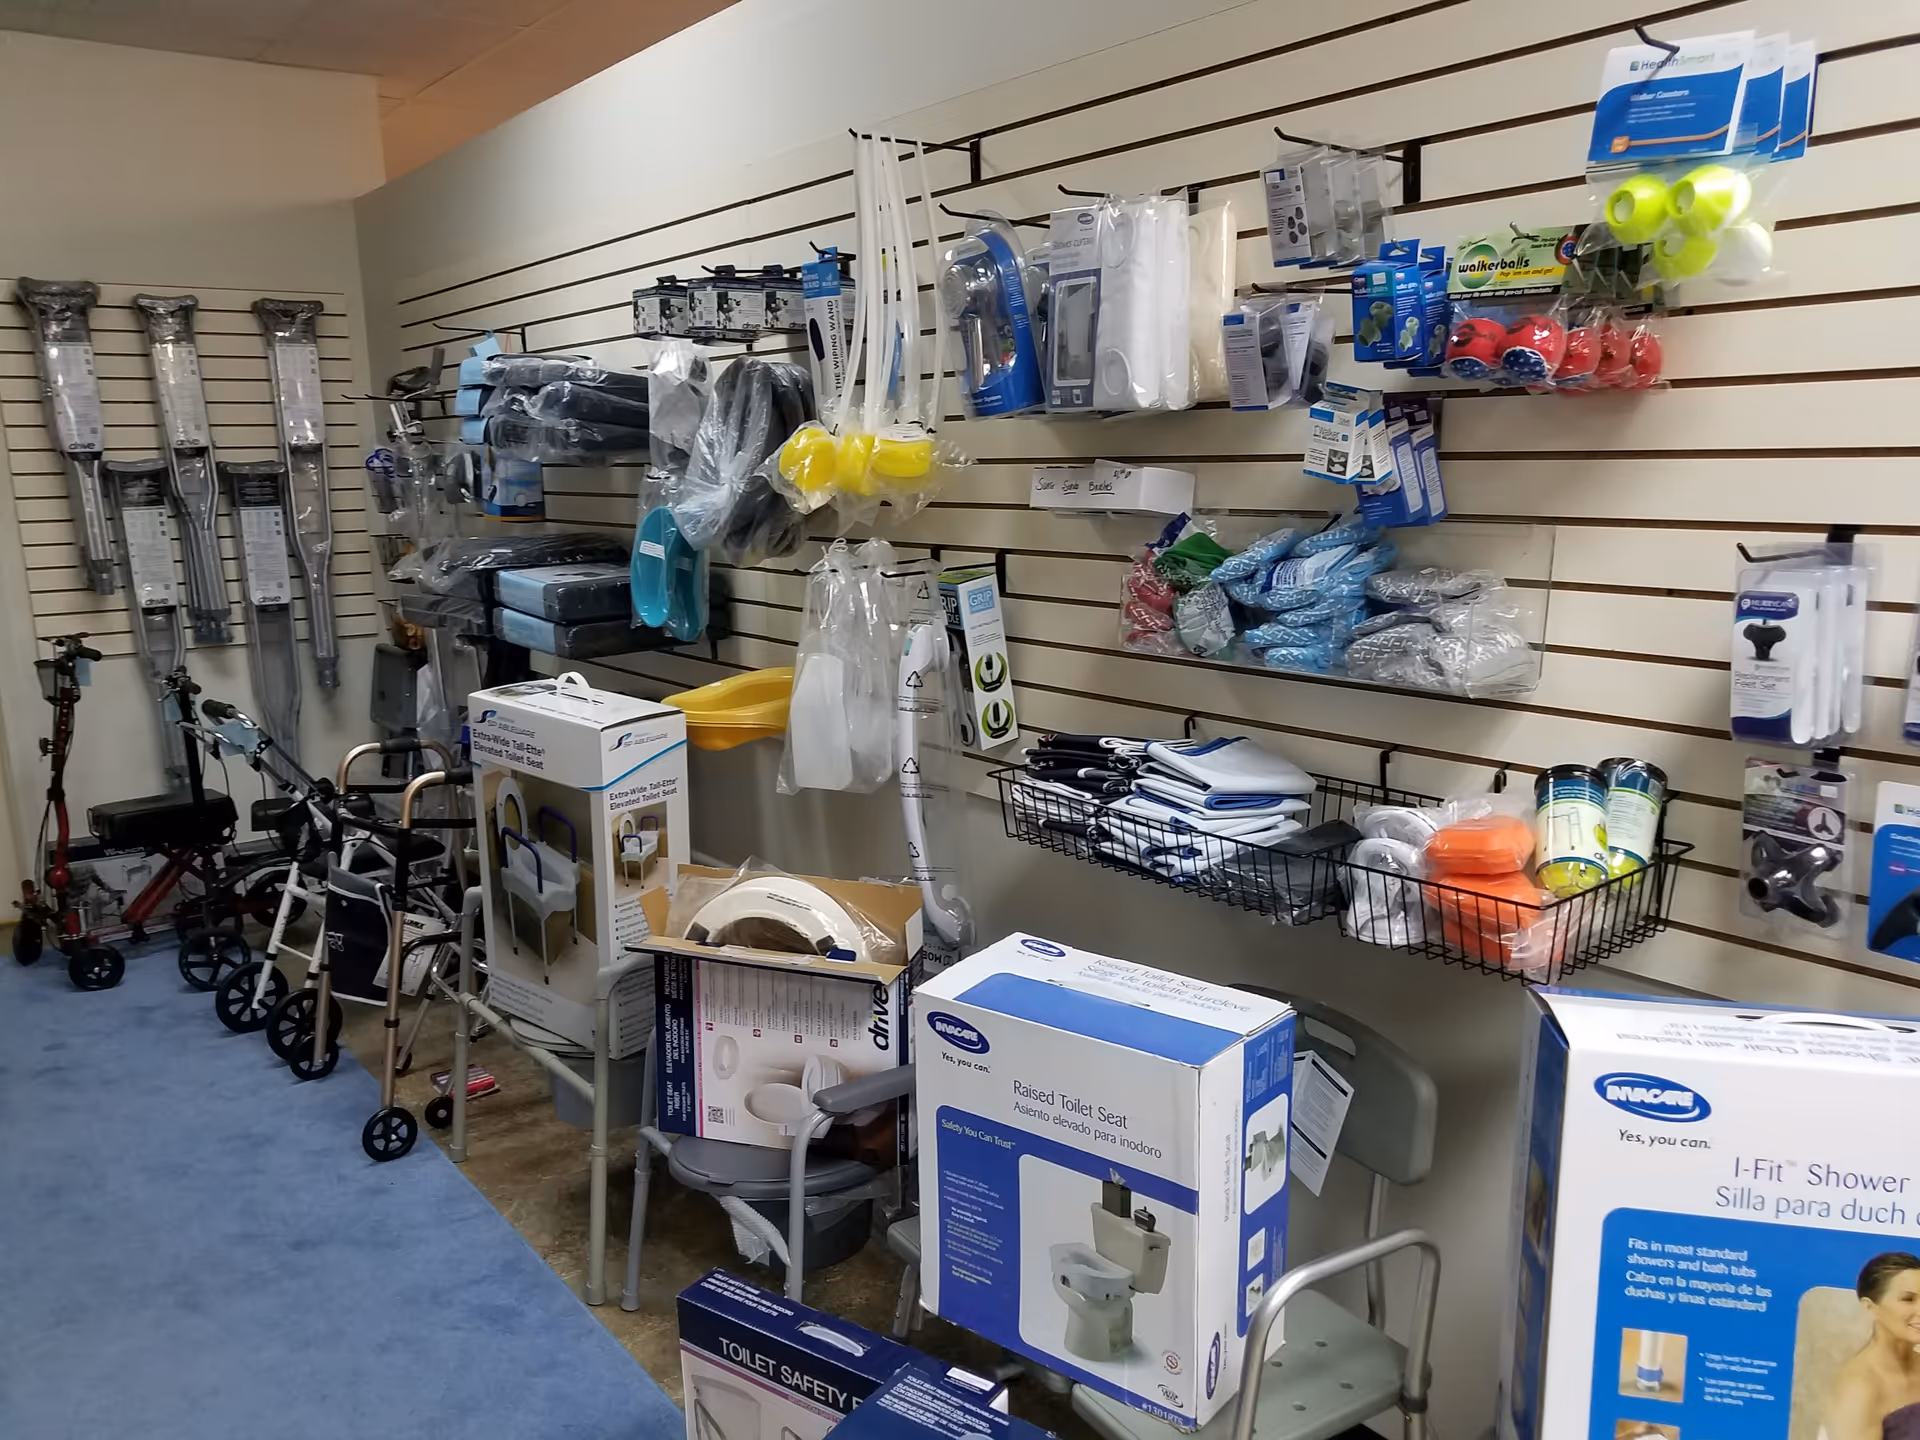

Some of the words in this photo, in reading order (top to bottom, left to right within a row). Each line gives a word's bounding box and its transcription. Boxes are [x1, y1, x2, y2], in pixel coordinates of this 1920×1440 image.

[1458, 256, 1530, 274] walkerballs
[827, 300, 836, 332] WAND
[828, 334, 839, 371] WIPING
[68, 440, 96, 450] drive
[144, 596, 169, 606] drive
[258, 594, 282, 604] drive
[970, 590, 992, 606] GRIP
[1734, 671, 1790, 683] Replacement
[1734, 679, 1757, 690] Feet
[1760, 682, 1776, 690] Set
[472, 728, 511, 748] Extra-Wide
[474, 740, 504, 758] Elevated
[504, 750, 526, 764] Toilet
[526, 757, 544, 770] Seat
[609, 786, 648, 802] Extra-Wide
[610, 794, 642, 811] Elevated
[642, 790, 660, 804] Toilet
[661, 786, 678, 798] Seat
[1094, 959, 1140, 976] Raised
[1140, 967, 1176, 986] Toilet
[1178, 978, 1208, 992] Seat
[664, 1004, 672, 1030] ASIENTO
[868, 984, 890, 1051] drive
[935, 1020, 978, 1042] INVACARE
[942, 1052, 956, 1064] Yes,
[957, 1058, 972, 1069] you
[1013, 1080, 1055, 1106] Raised
[1058, 1093, 1094, 1119] Toilet
[1097, 1106, 1128, 1130] Seat
[1606, 1085, 1694, 1109] INVACARE
[941, 1118, 964, 1135] Safety
[963, 1124, 978, 1139] You
[978, 1130, 993, 1144] Can
[1014, 1101, 1050, 1123] Asiento
[1052, 1113, 1091, 1136] elevado
[1094, 1128, 1117, 1144] para
[1120, 1136, 1162, 1159] inodoro
[1618, 1128, 1645, 1145] Yes,
[1648, 1135, 1677, 1149] you
[1680, 1136, 1712, 1150] can.
[1807, 1162, 1912, 1194] Shower
[1716, 1184, 1766, 1212] Silla
[1775, 1194, 1832, 1220] para
[1841, 1198, 1906, 1225] duch
[1628, 1237, 1648, 1250] Fits
[1651, 1240, 1662, 1252] in
[1664, 1245, 1694, 1256] most
[1696, 1247, 1748, 1262] standard
[1626, 1253, 1675, 1269] showers
[1677, 1260, 1700, 1272] and
[1702, 1262, 1729, 1275] bath
[1730, 1266, 1757, 1278] tubs
[1624, 1284, 1666, 1300] duchas
[1668, 1292, 1678, 1304] y
[1678, 1292, 1706, 1306] tinas
[1658, 1276, 1674, 1286] en
[1676, 1276, 1686, 1288] la
[1738, 1282, 1753, 1296] de
[1755, 1284, 1773, 1298] las
[718, 1337, 776, 1377] TOILET
[780, 1364, 848, 1409] SAFETY
